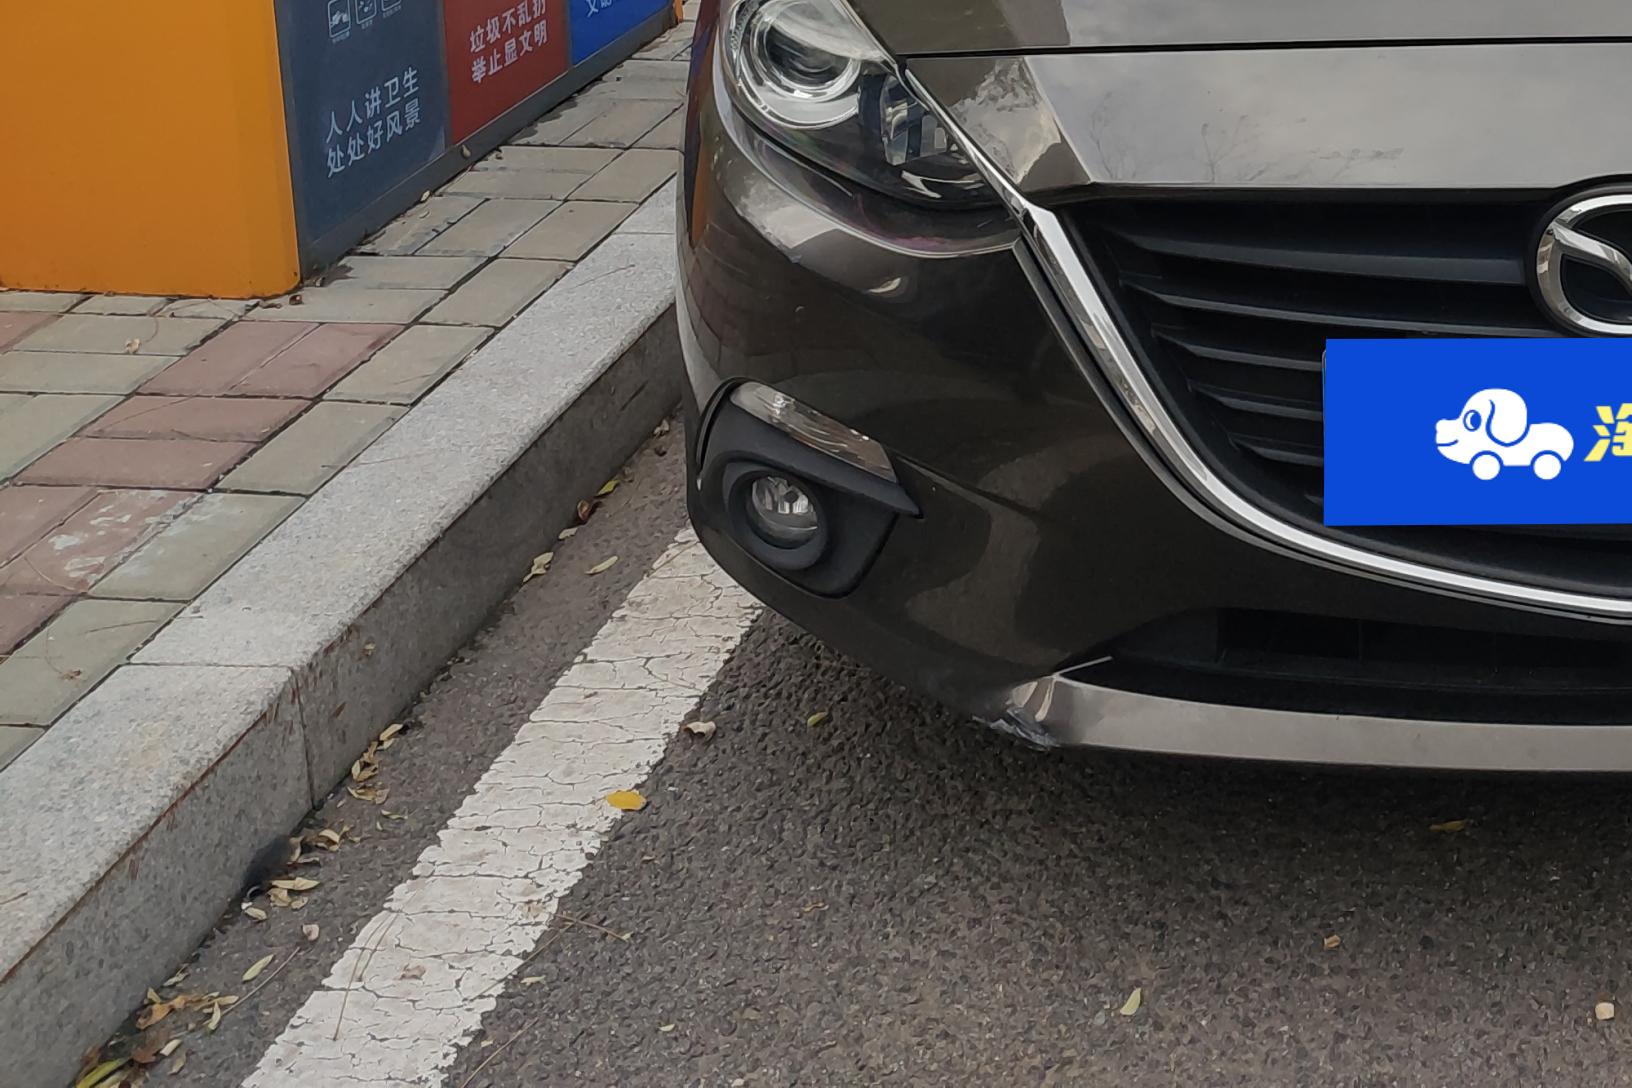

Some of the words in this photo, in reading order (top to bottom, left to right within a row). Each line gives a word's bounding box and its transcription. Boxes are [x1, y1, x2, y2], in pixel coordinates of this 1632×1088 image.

[472, 19, 548, 83] 举止显文明
[326, 67, 419, 143] 人人讲卫生
[327, 98, 420, 178] 处处好风景
